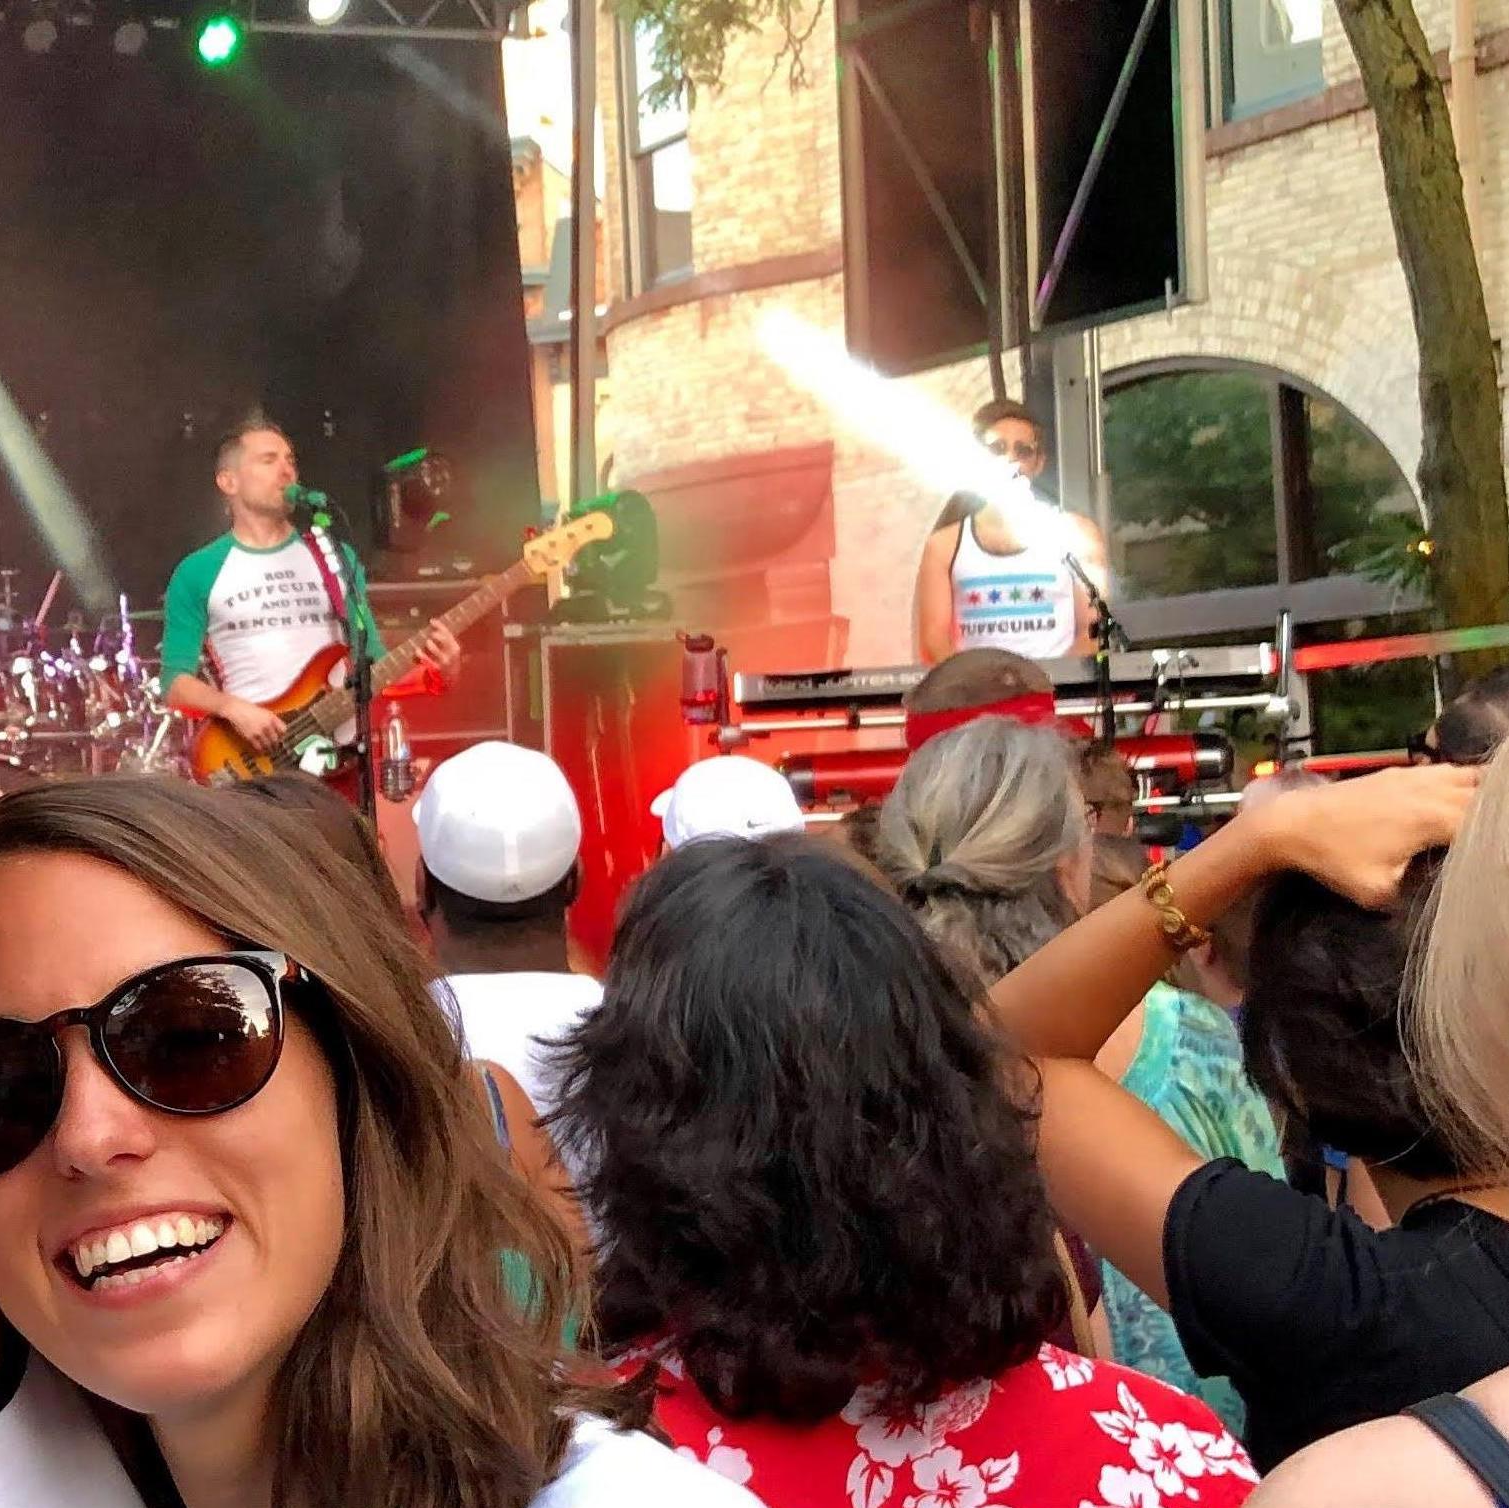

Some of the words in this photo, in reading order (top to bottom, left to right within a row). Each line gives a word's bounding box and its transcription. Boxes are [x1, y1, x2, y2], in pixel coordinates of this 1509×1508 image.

[264, 570, 296, 581] ROD
[261, 599, 291, 610] AND
[295, 597, 320, 607] THE
[227, 616, 293, 631] BENCH
[960, 617, 1056, 637] TUFFCURLS
